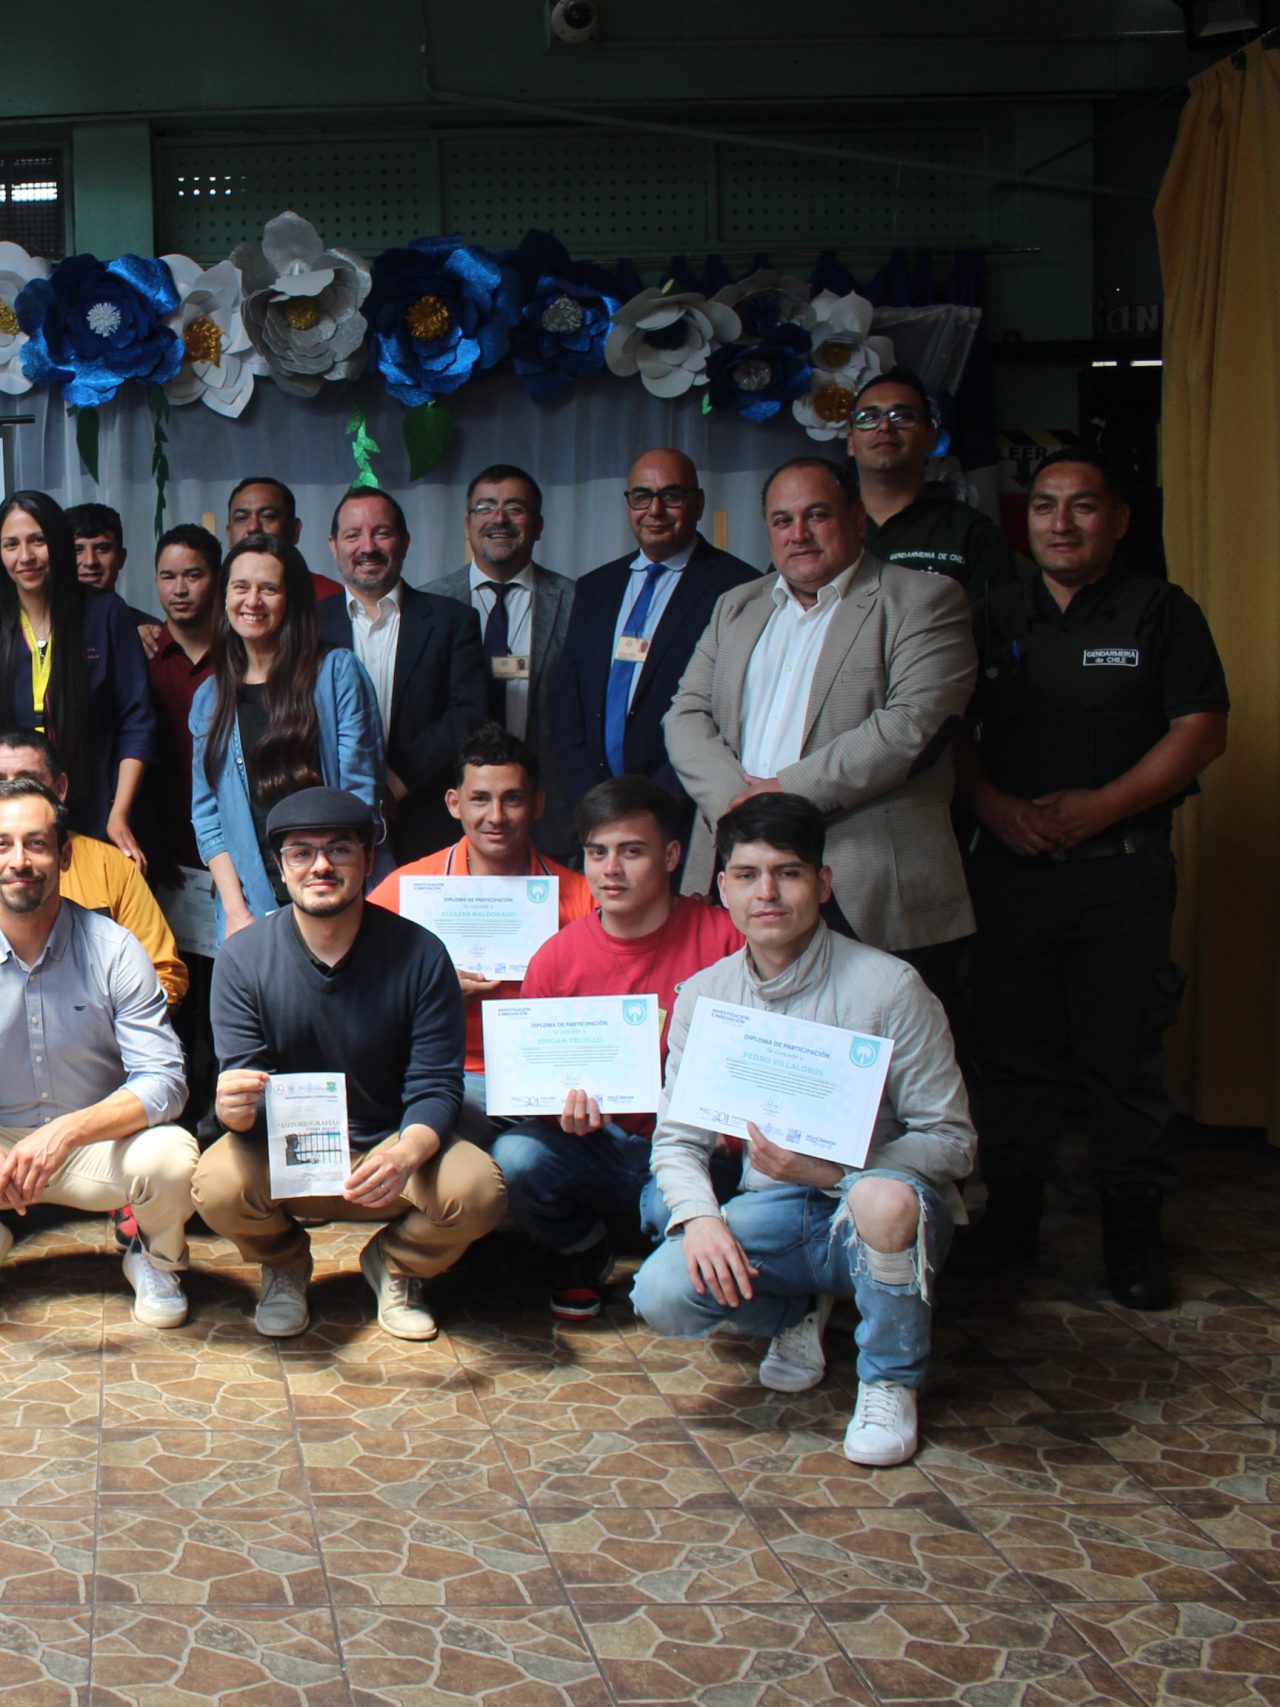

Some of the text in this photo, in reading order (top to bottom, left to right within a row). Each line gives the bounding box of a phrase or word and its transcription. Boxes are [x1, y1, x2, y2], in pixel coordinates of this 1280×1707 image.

[937, 552, 948, 561] DE
[1086, 650, 1136, 658] GENDARMERIA
[1106, 656, 1127, 664] CHILE
[743, 1033, 831, 1060] DIPLOMA DE PARTICIPACIÓN
